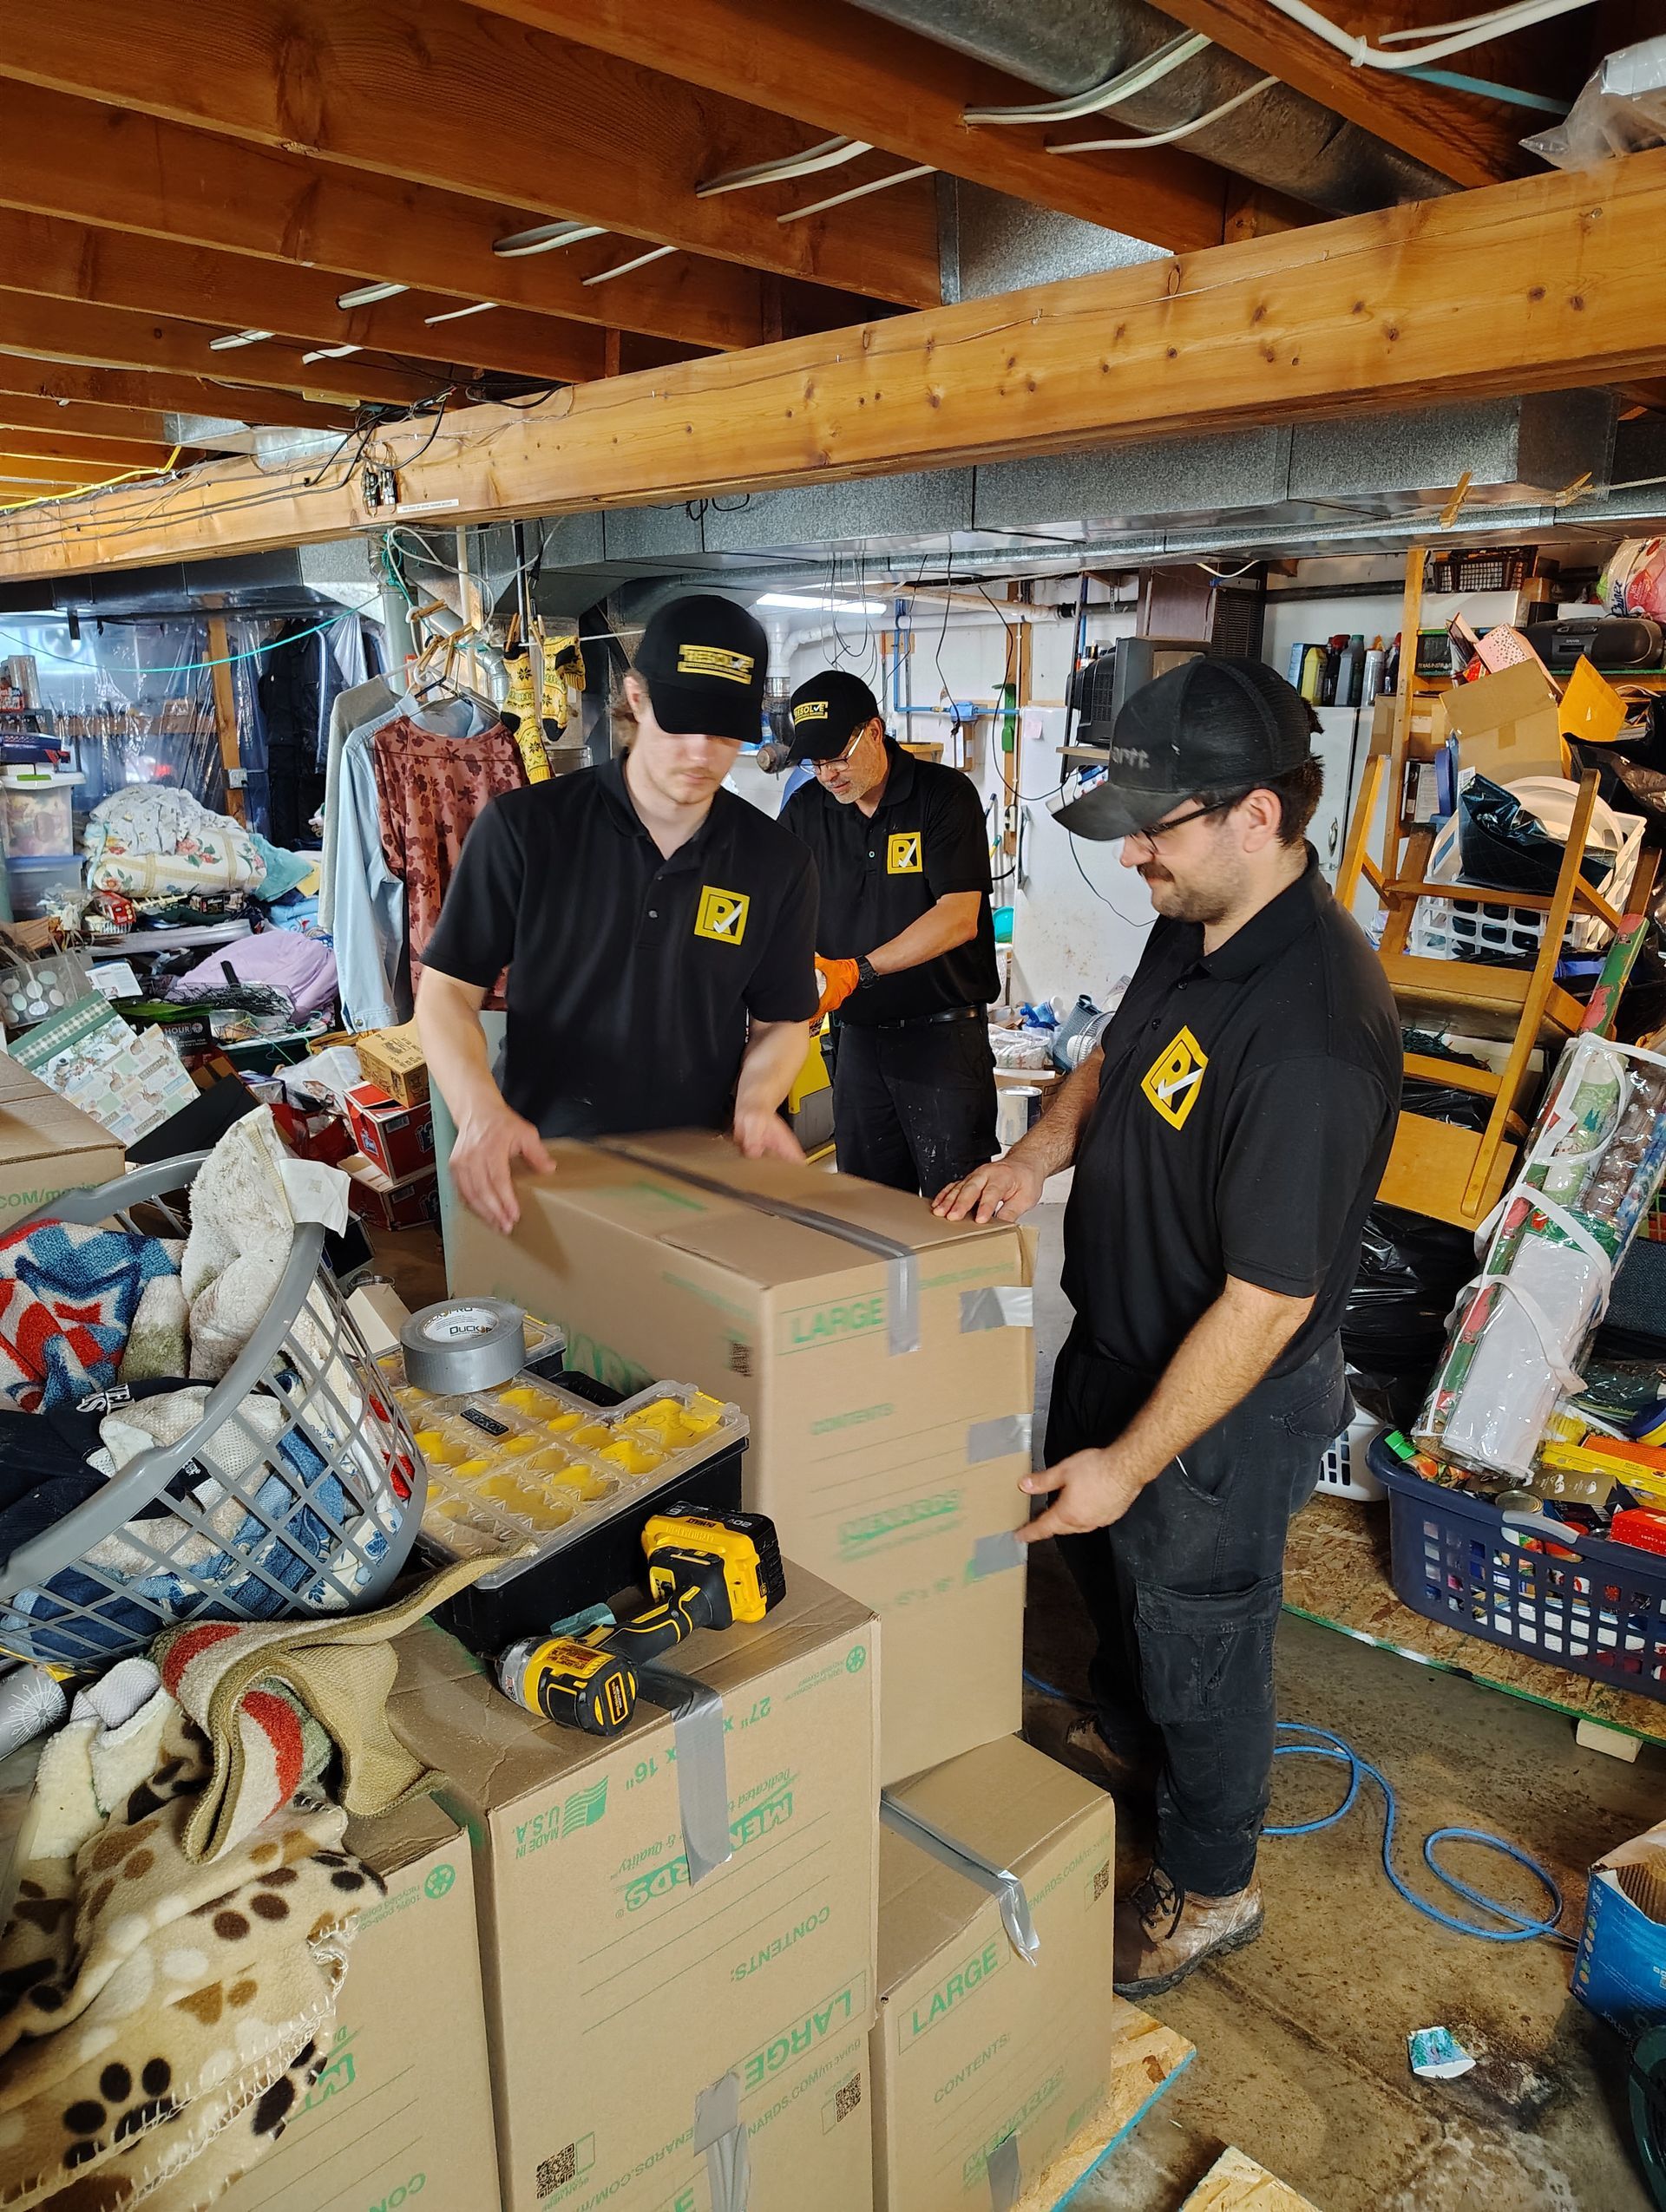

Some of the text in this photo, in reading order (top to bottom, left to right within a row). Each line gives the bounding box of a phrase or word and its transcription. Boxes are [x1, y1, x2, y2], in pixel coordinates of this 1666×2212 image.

[165, 1025, 190, 1034] HOUR
[789, 1298, 885, 1345] LARGE
[740, 1696, 771, 1729] 27"
[626, 1757, 659, 1790] 16"
[738, 1769, 790, 1809] Dedicated
[512, 1805, 560, 1844] U.S.A.
[515, 1827, 559, 1860] MADE IN
[730, 1906, 830, 1983] CONTENTS:
[912, 1942, 998, 2036] LARGE
[744, 1989, 852, 2091] LARGE
